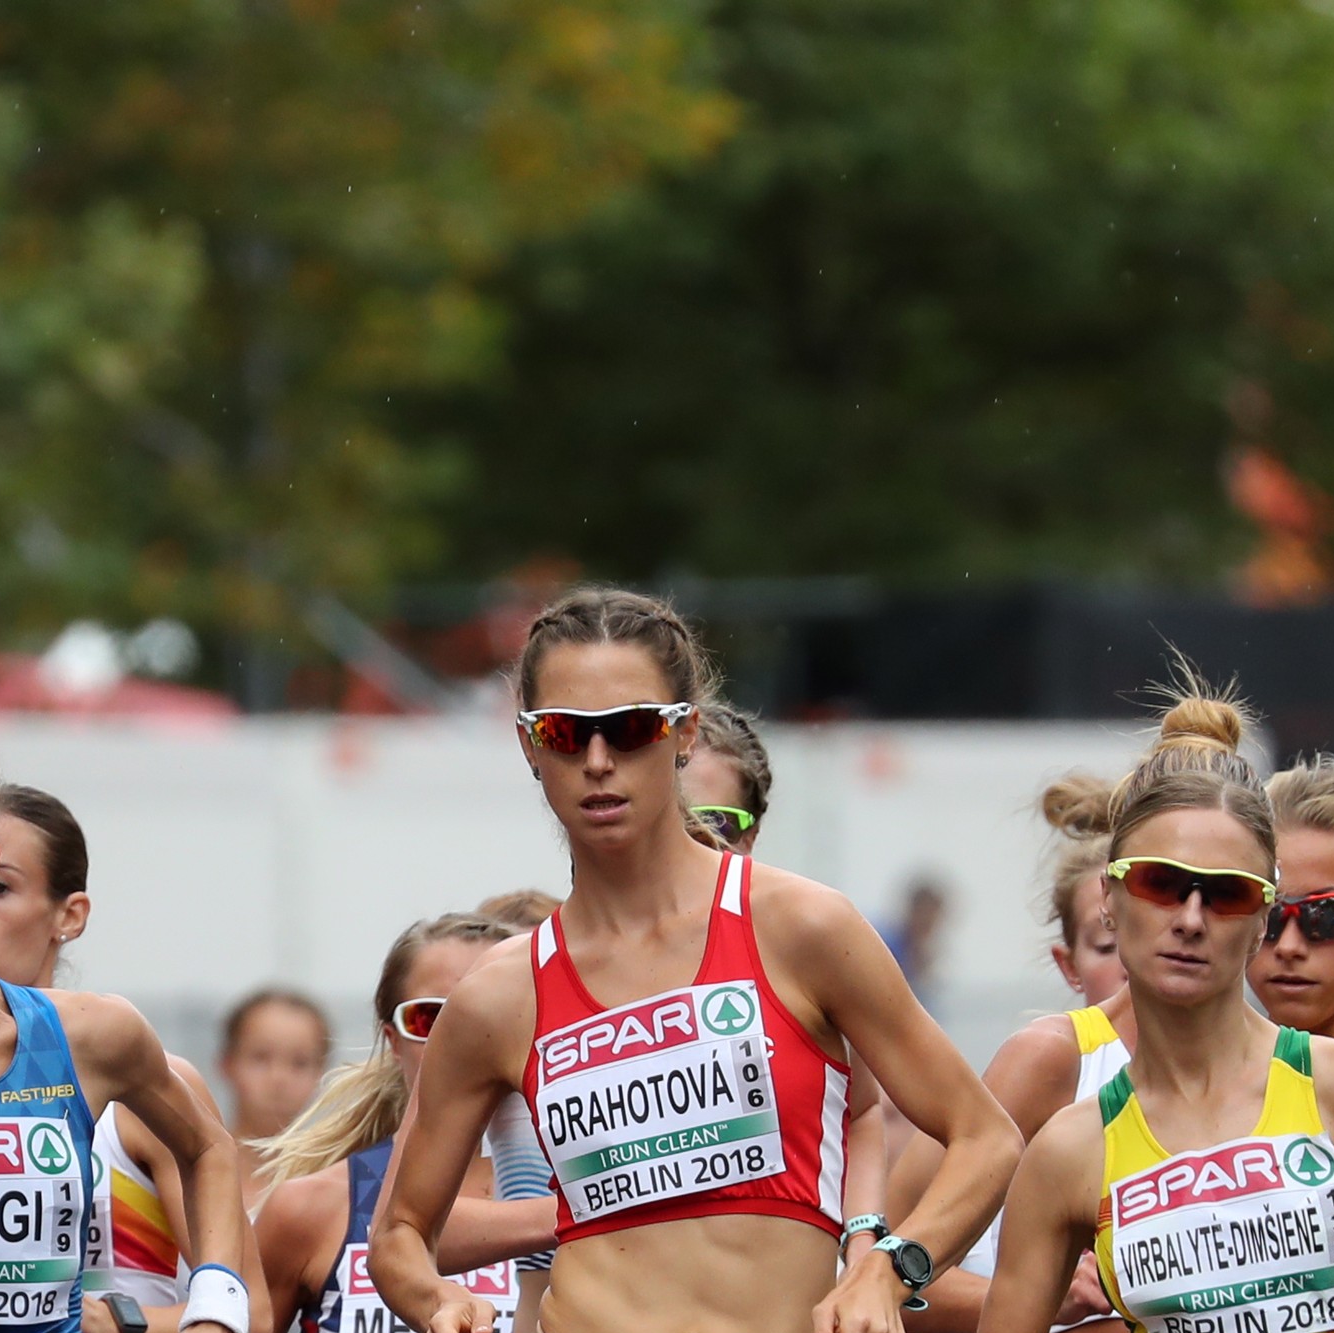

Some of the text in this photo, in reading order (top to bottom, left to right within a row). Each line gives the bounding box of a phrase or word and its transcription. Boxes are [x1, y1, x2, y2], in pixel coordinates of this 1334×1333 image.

[546, 1001, 693, 1076] SPAR
[547, 1050, 734, 1146] DRAHOTOVÁ
[584, 1145, 765, 1211] BERLIN 2018
[609, 1141, 650, 1167] RUN
[1121, 1149, 1278, 1219] SPAR
[1190, 1289, 1236, 1311] RUN
